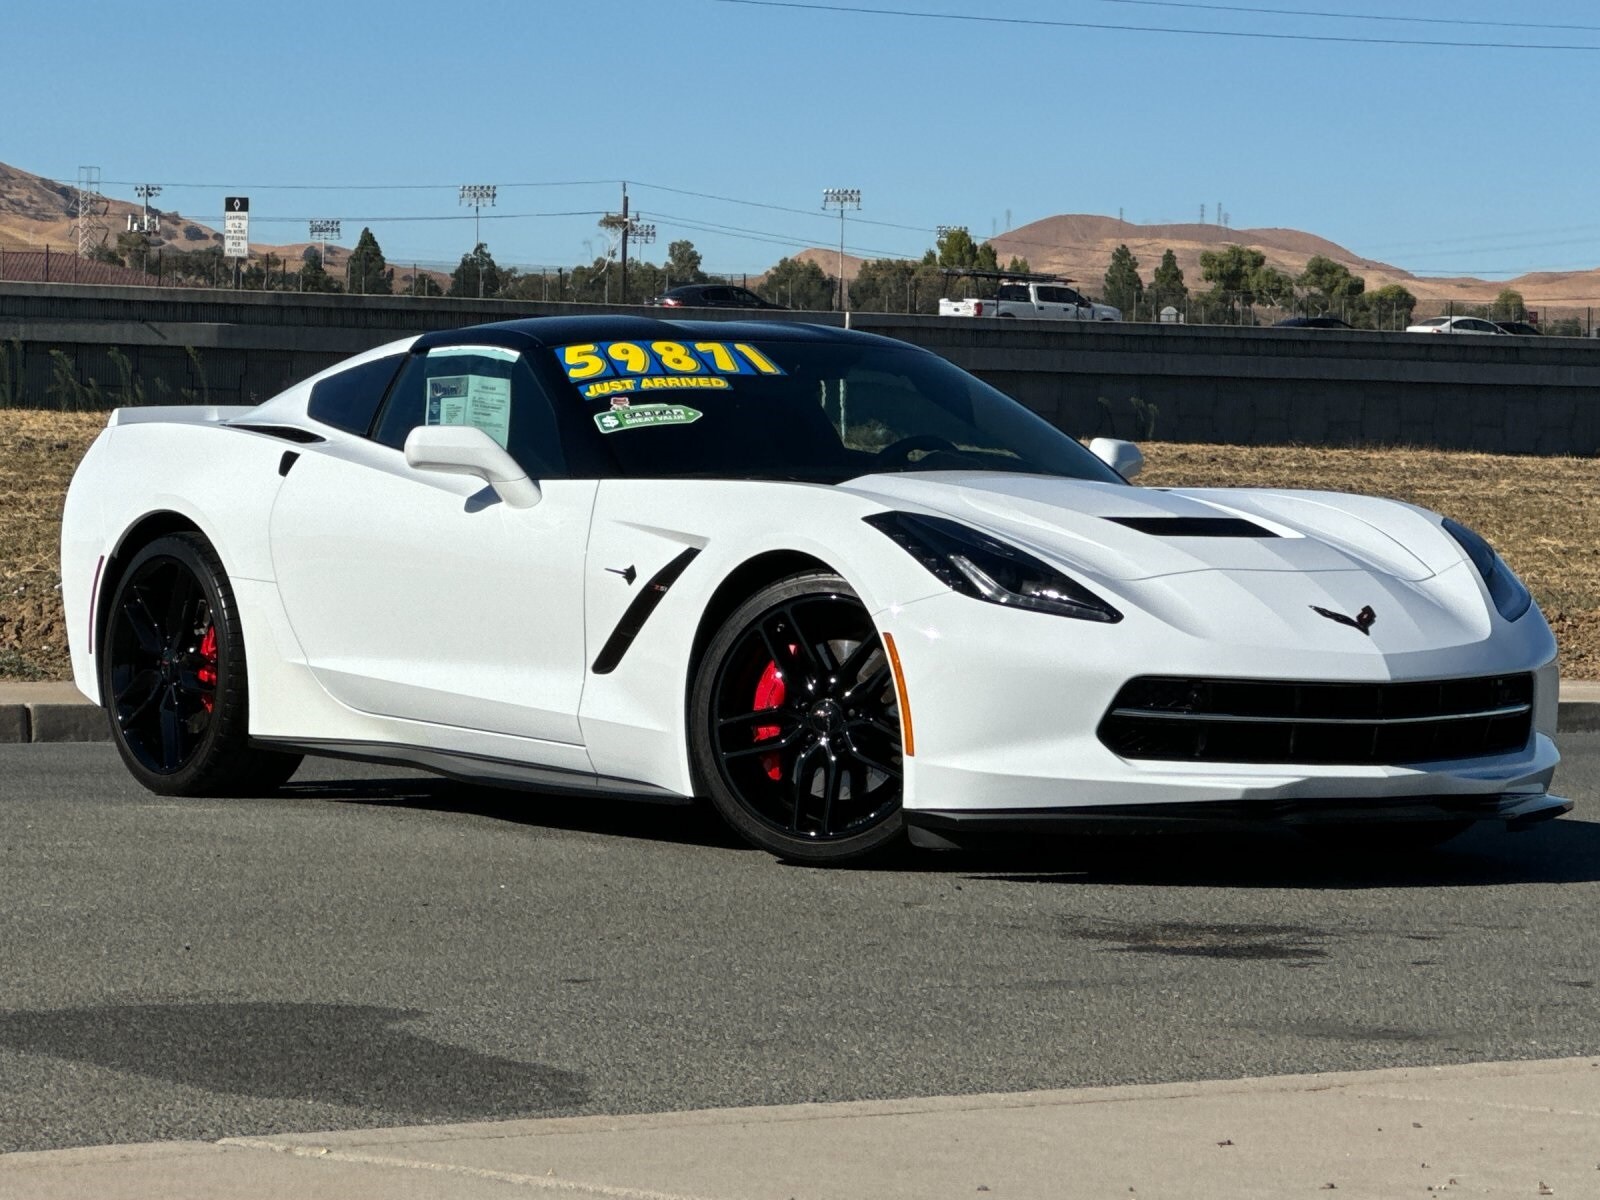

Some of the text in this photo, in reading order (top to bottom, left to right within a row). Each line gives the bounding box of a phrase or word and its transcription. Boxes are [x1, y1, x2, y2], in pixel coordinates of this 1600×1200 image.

[564, 340, 780, 378] 59871
[584, 376, 728, 397] JUST ARRIVED
[623, 409, 685, 420] CARFAX
[625, 414, 686, 425] GREAT VALUE
[601, 415, 619, 428] $
